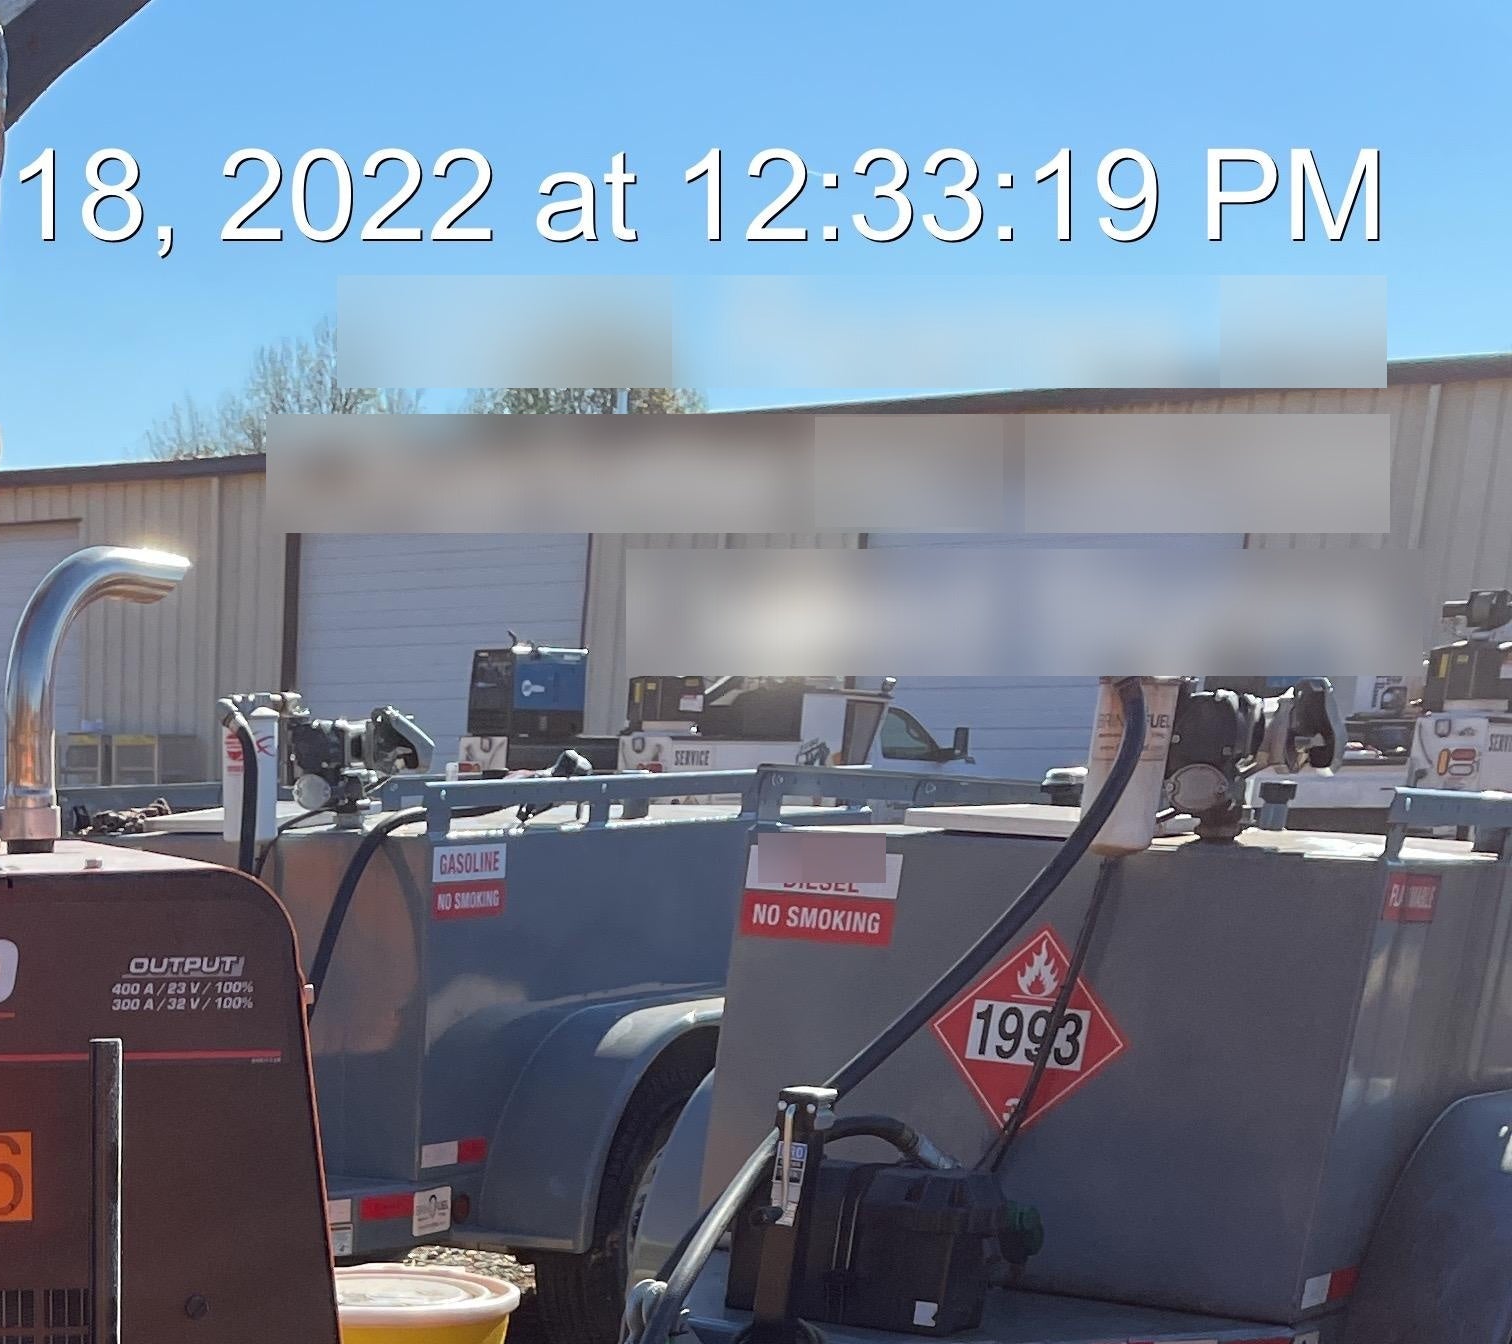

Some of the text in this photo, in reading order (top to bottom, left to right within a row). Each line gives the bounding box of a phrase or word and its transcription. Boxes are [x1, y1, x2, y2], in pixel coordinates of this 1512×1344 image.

[674, 750, 710, 766] SERVICE
[440, 850, 500, 875] GASOLINE
[437, 889, 500, 911] NO SMOKING
[752, 903, 881, 934] NO SMOKING
[129, 956, 238, 974] OUTPUT
[112, 983, 140, 995] 400
[143, 982, 154, 995] A
[215, 980, 254, 993] 100%
[112, 999, 140, 1011] 300
[143, 998, 154, 1010] A
[215, 997, 254, 1009] 100%
[977, 1004, 1083, 1066] 1993
